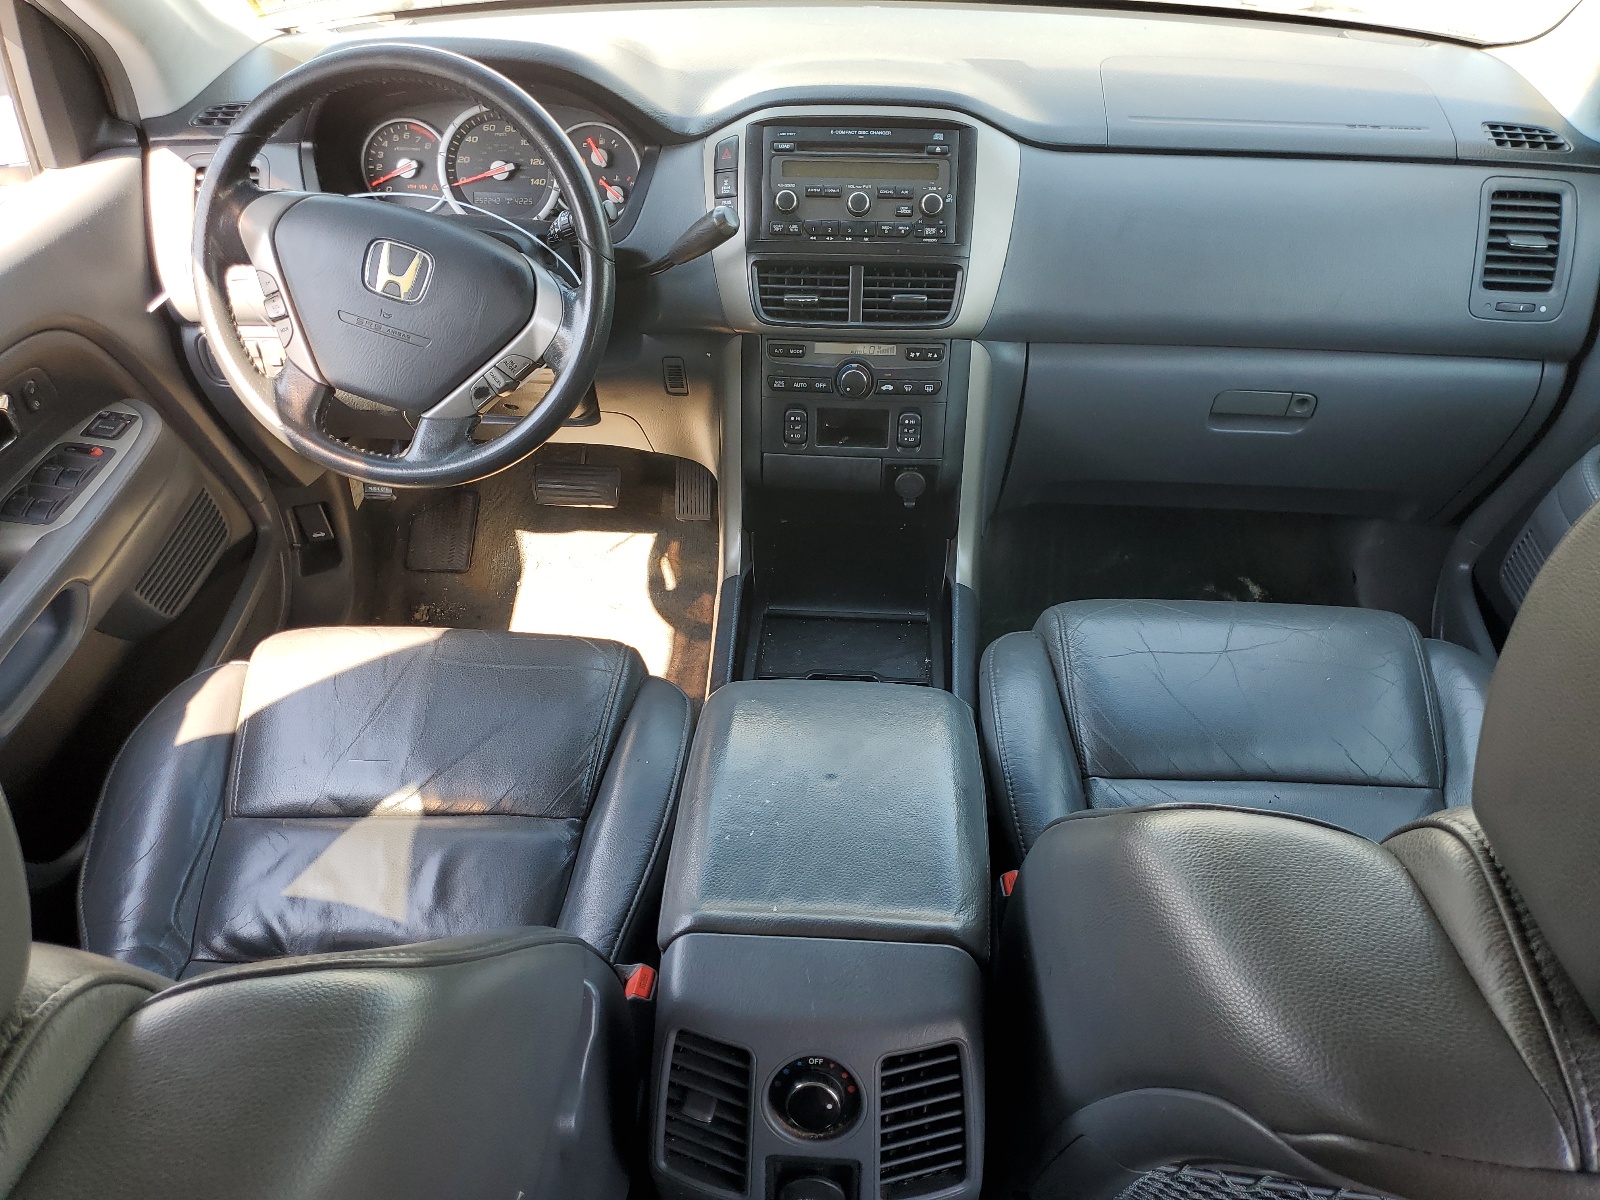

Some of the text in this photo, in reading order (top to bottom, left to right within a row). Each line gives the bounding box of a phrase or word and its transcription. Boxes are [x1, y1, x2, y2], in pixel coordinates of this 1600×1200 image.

[482, 124, 496, 132] 60
[392, 134, 400, 142] 5
[403, 132, 410, 140] 6
[382, 140, 388, 148] 4
[458, 156, 470, 164] 20
[530, 158, 545, 166] 120
[530, 178, 546, 186] 140
